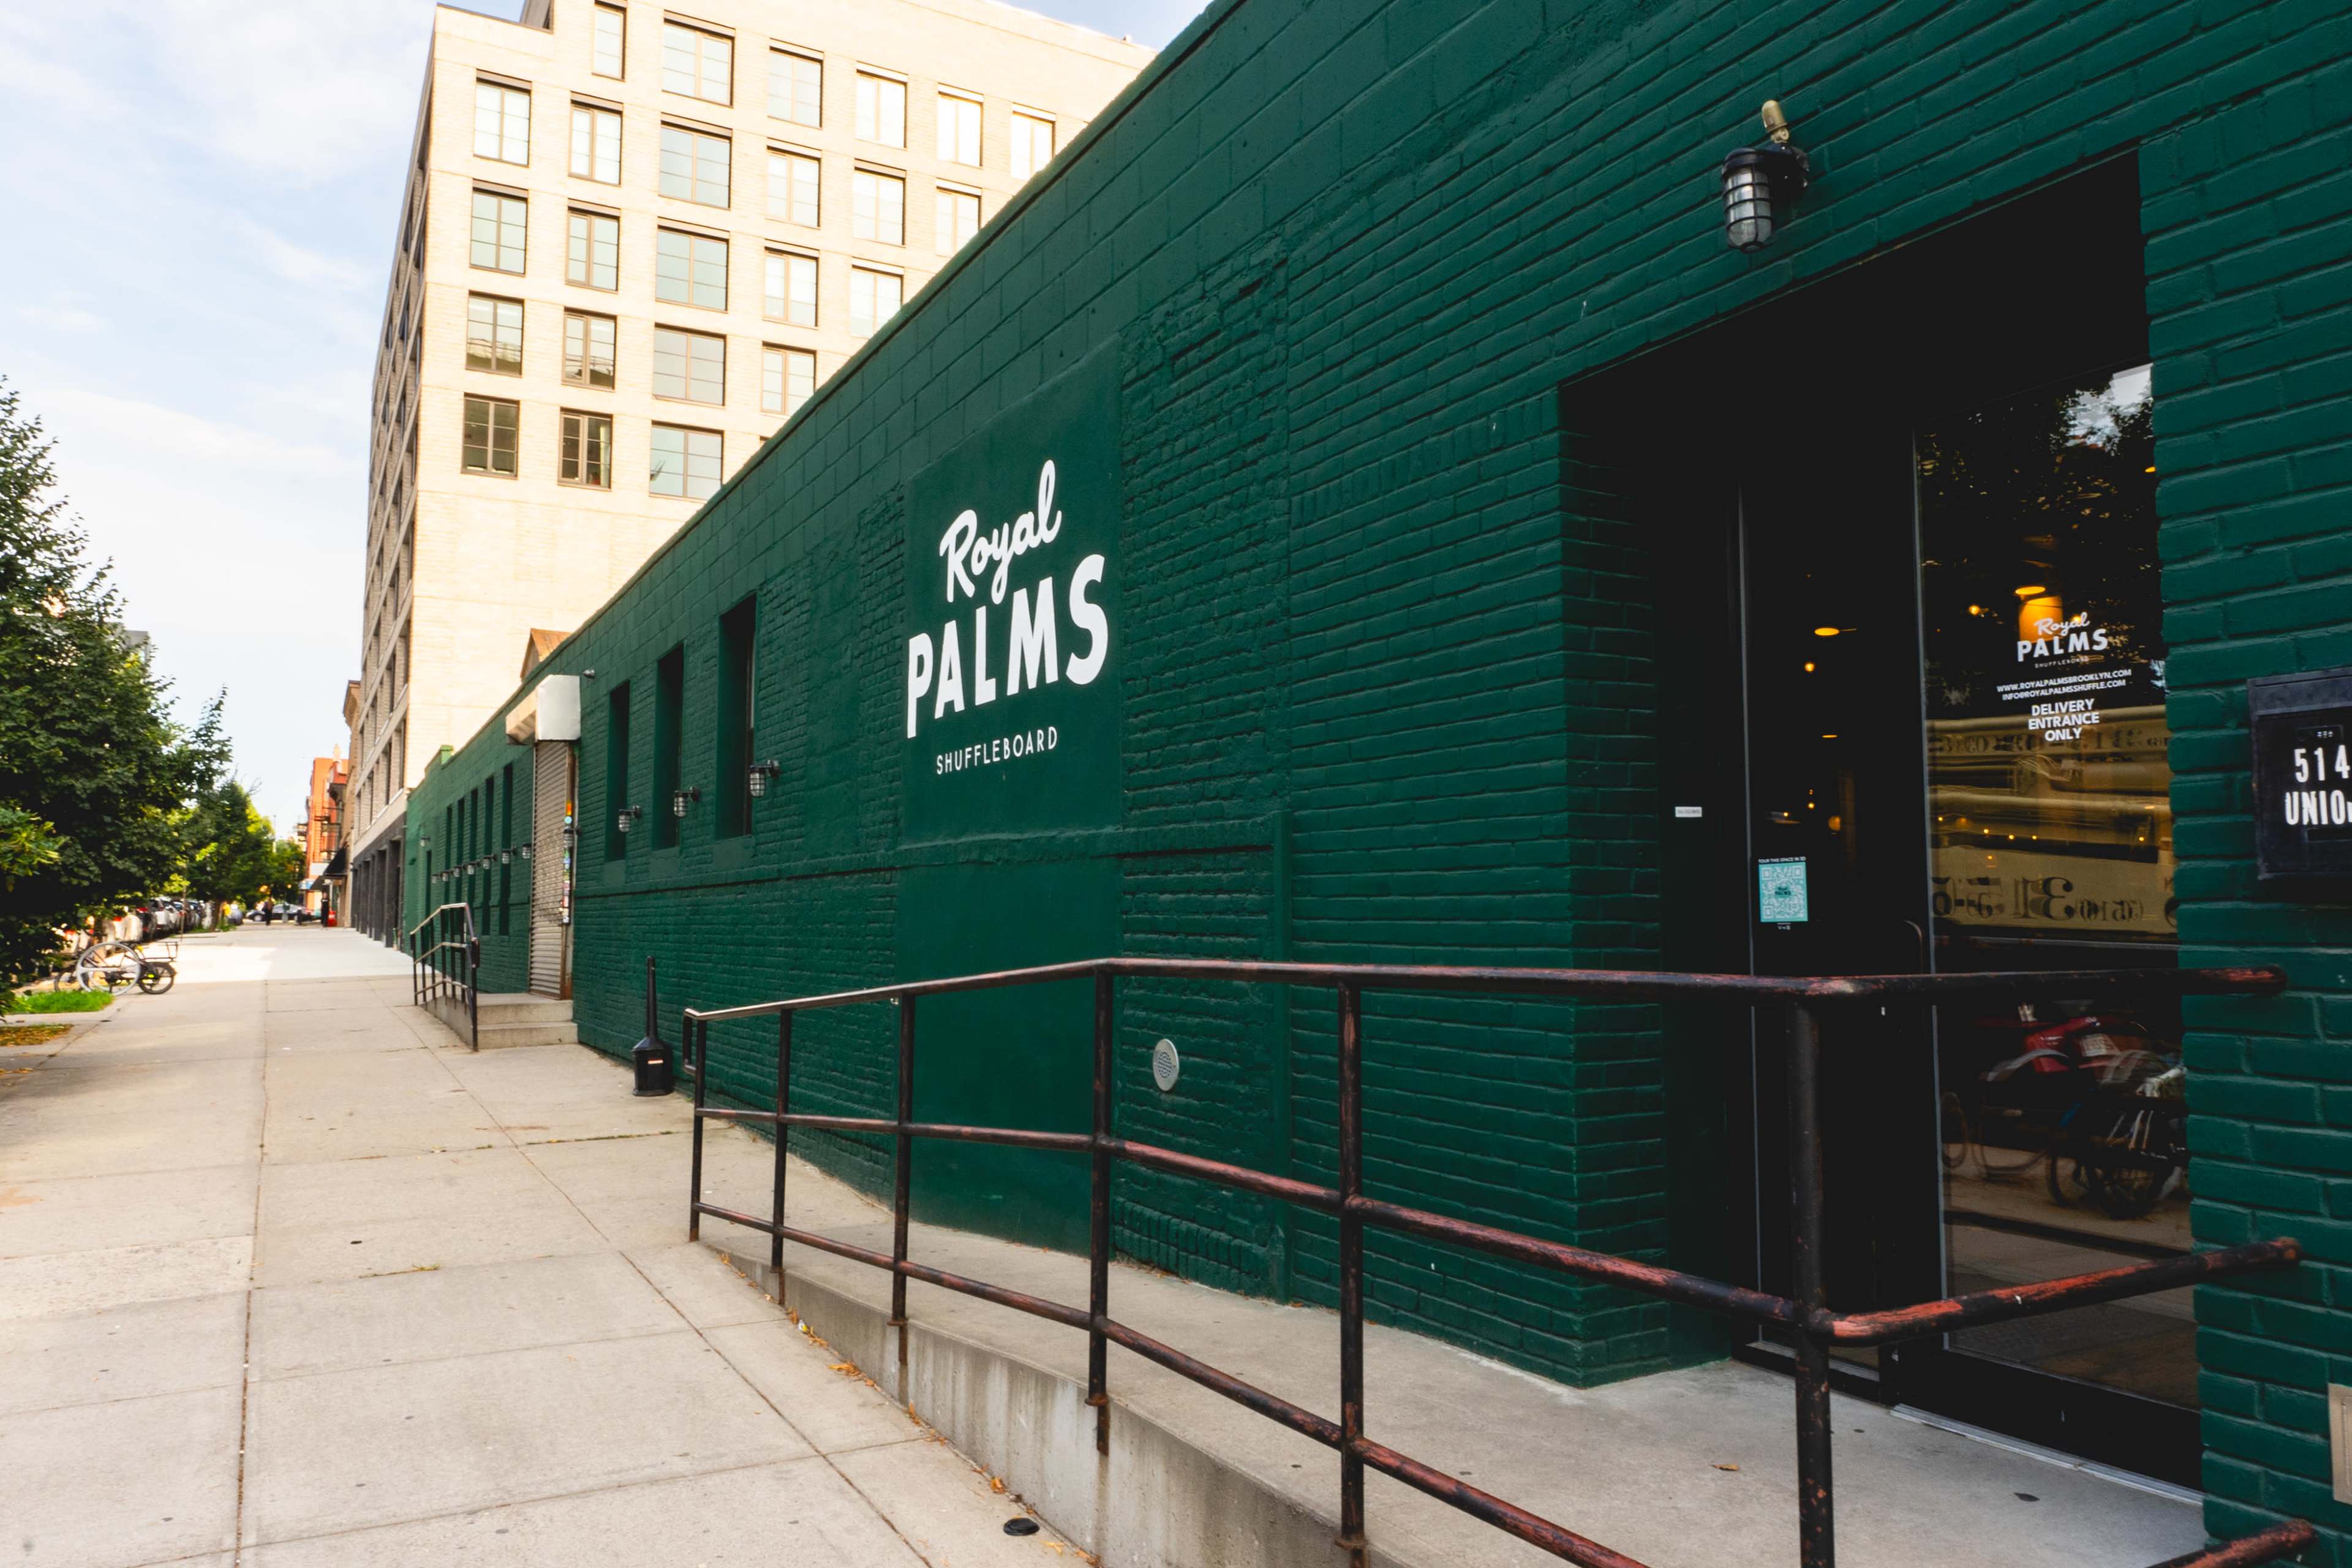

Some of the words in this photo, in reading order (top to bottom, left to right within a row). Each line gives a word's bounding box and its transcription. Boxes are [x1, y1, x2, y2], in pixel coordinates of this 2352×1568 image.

[940, 459, 1061, 605] Royal
[2034, 612, 2090, 636] Royal
[907, 554, 1108, 739] PALMS
[2017, 628, 2108, 662] PALMS
[1996, 669, 2132, 693] WWW.ROYALPALMSBROOKLYN.COM
[2028, 712, 2100, 730] ENTRANCE
[2031, 698, 2095, 716] DELIVERY
[2045, 727, 2082, 742] ONLY
[937, 726, 1058, 775] SHUFFLEBOARD
[2294, 745, 2351, 783] 514
